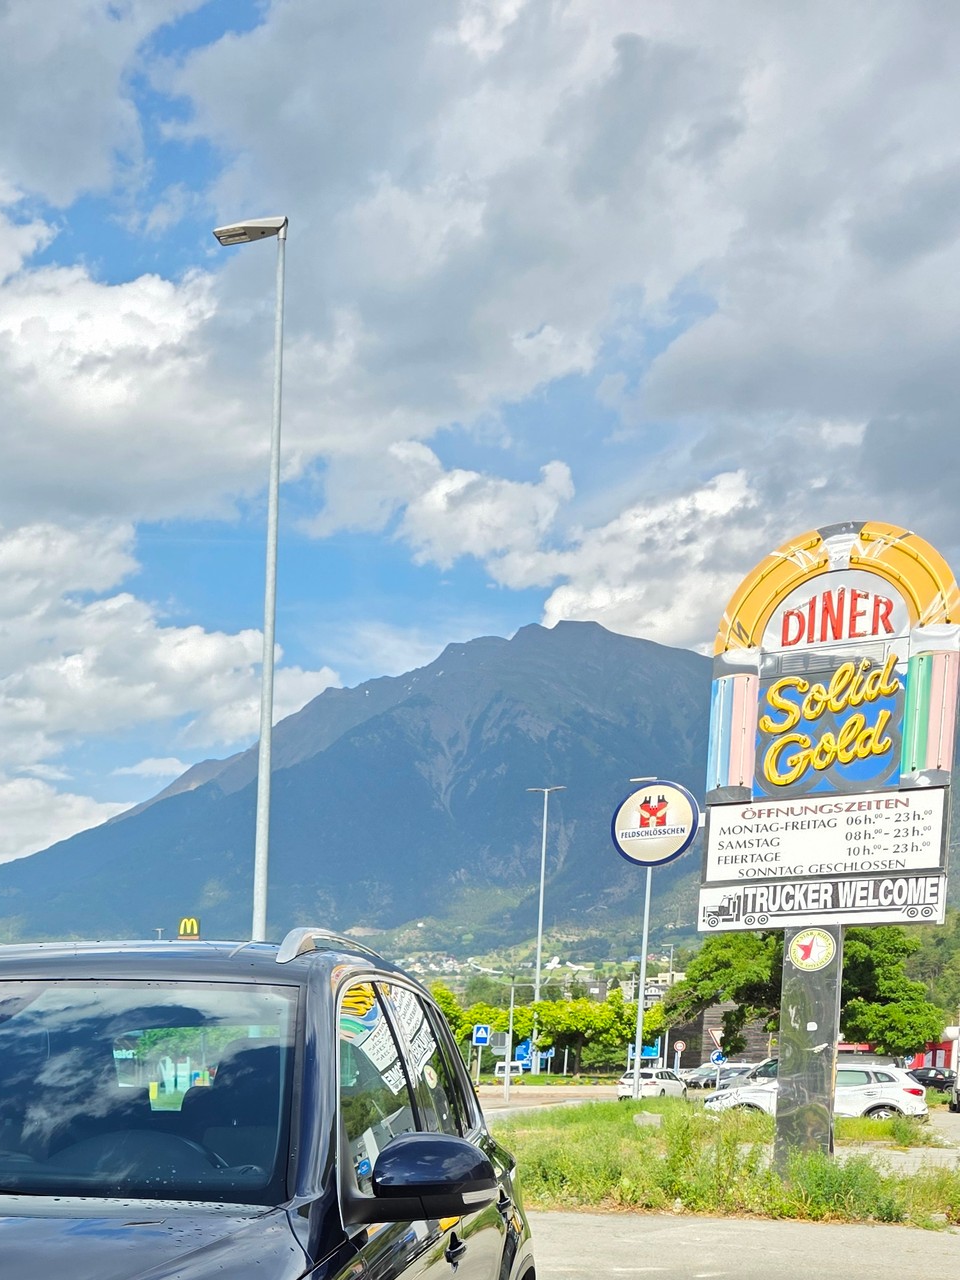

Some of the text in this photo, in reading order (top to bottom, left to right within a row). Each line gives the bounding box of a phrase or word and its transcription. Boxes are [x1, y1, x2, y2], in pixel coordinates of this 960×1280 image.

[781, 587, 895, 647] DINER
[759, 654, 899, 734] Solid
[764, 710, 892, 786] Gold
[741, 798, 910, 820] ÖFFNUNGSZEITEN
[620, 826, 686, 839] FELDSCHLÖSSCHEN
[719, 817, 837, 836] MONTAG-FREITAG
[717, 837, 780, 851] SAMSTAG
[717, 852, 781, 865] FEIERTAGE
[738, 859, 906, 878] SONNTAG GESCHLOSSEN
[744, 877, 939, 914] TRUCKER WELCOME
